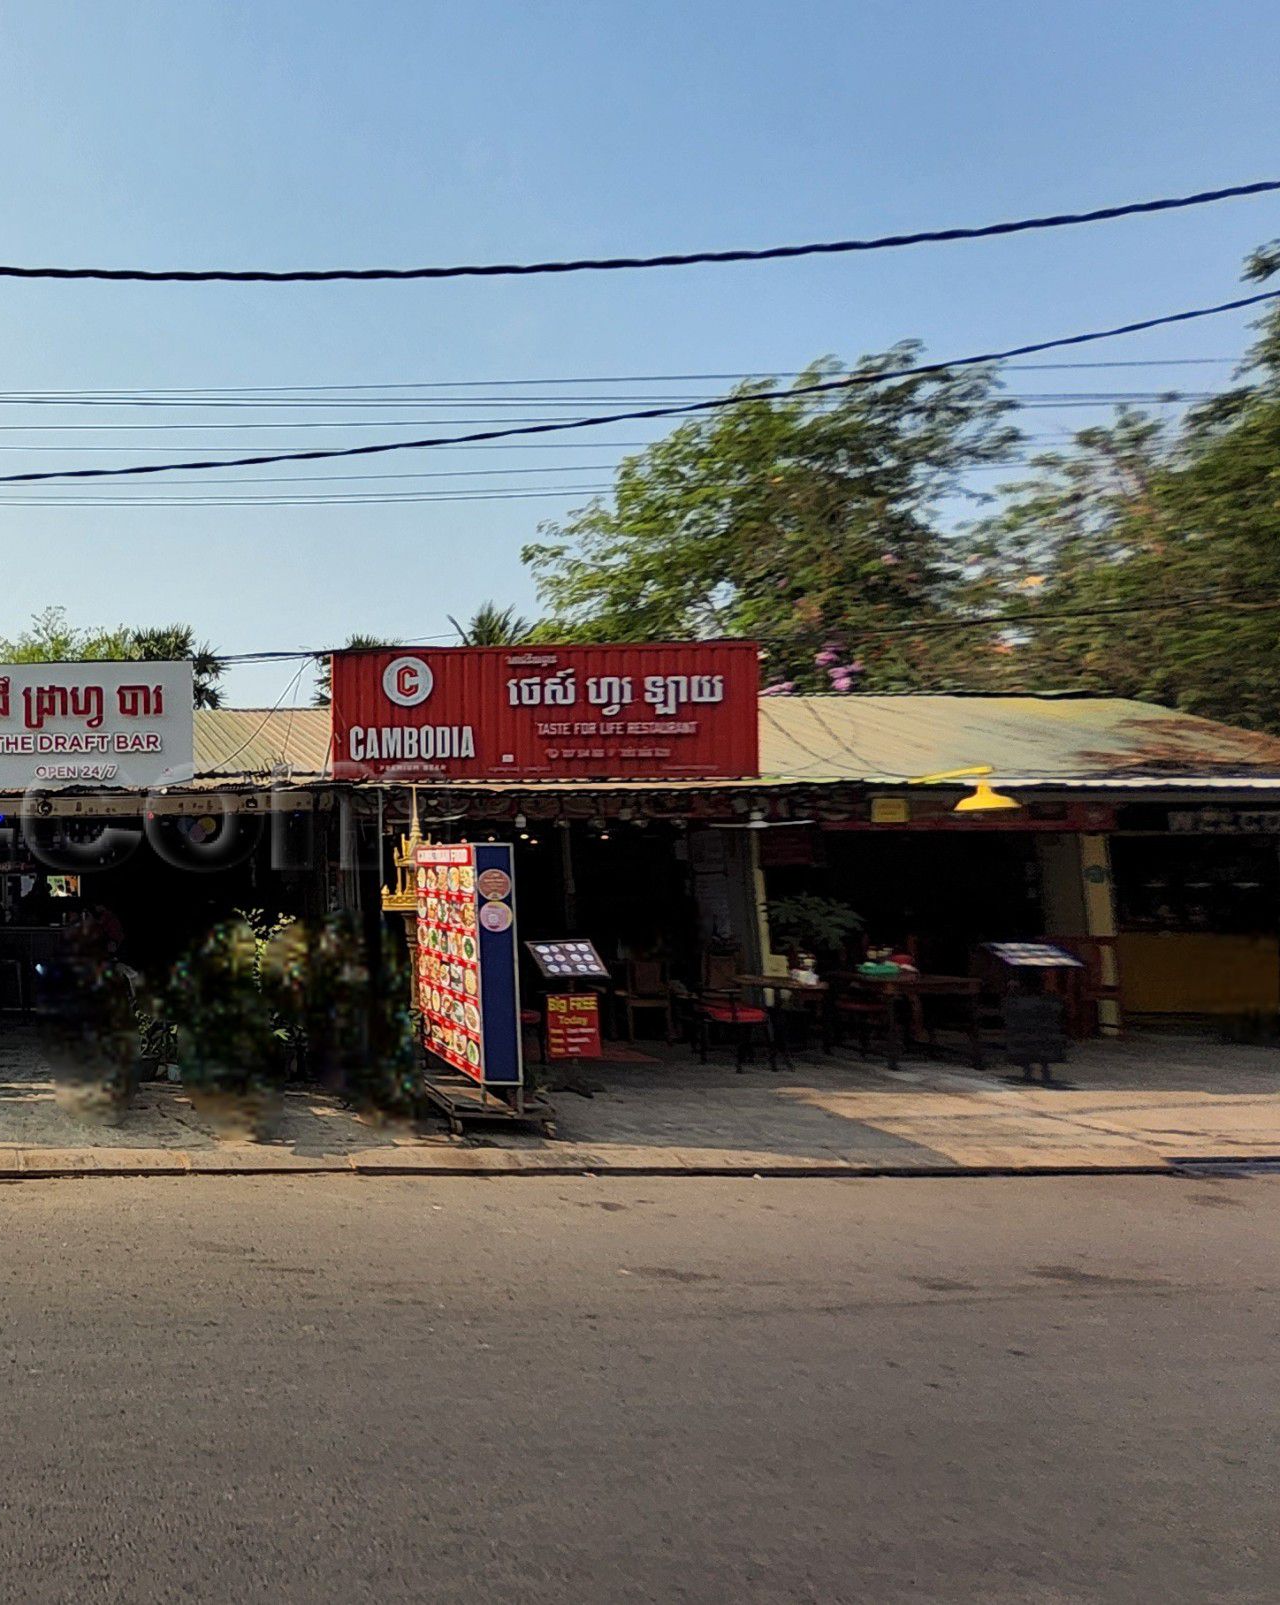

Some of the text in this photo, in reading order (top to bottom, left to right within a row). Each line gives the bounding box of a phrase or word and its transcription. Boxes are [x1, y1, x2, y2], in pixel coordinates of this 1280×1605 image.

[536, 720, 698, 735] TASTE FOR LIFE RESTAURANT
[38, 734, 109, 752] DRAFT
[115, 733, 160, 751] BAR
[349, 725, 476, 762] CAMBODIA
[35, 764, 118, 780] OPEN 24/7
[379, 764, 420, 772] PREMIUM
[557, 1015, 588, 1026] Today
